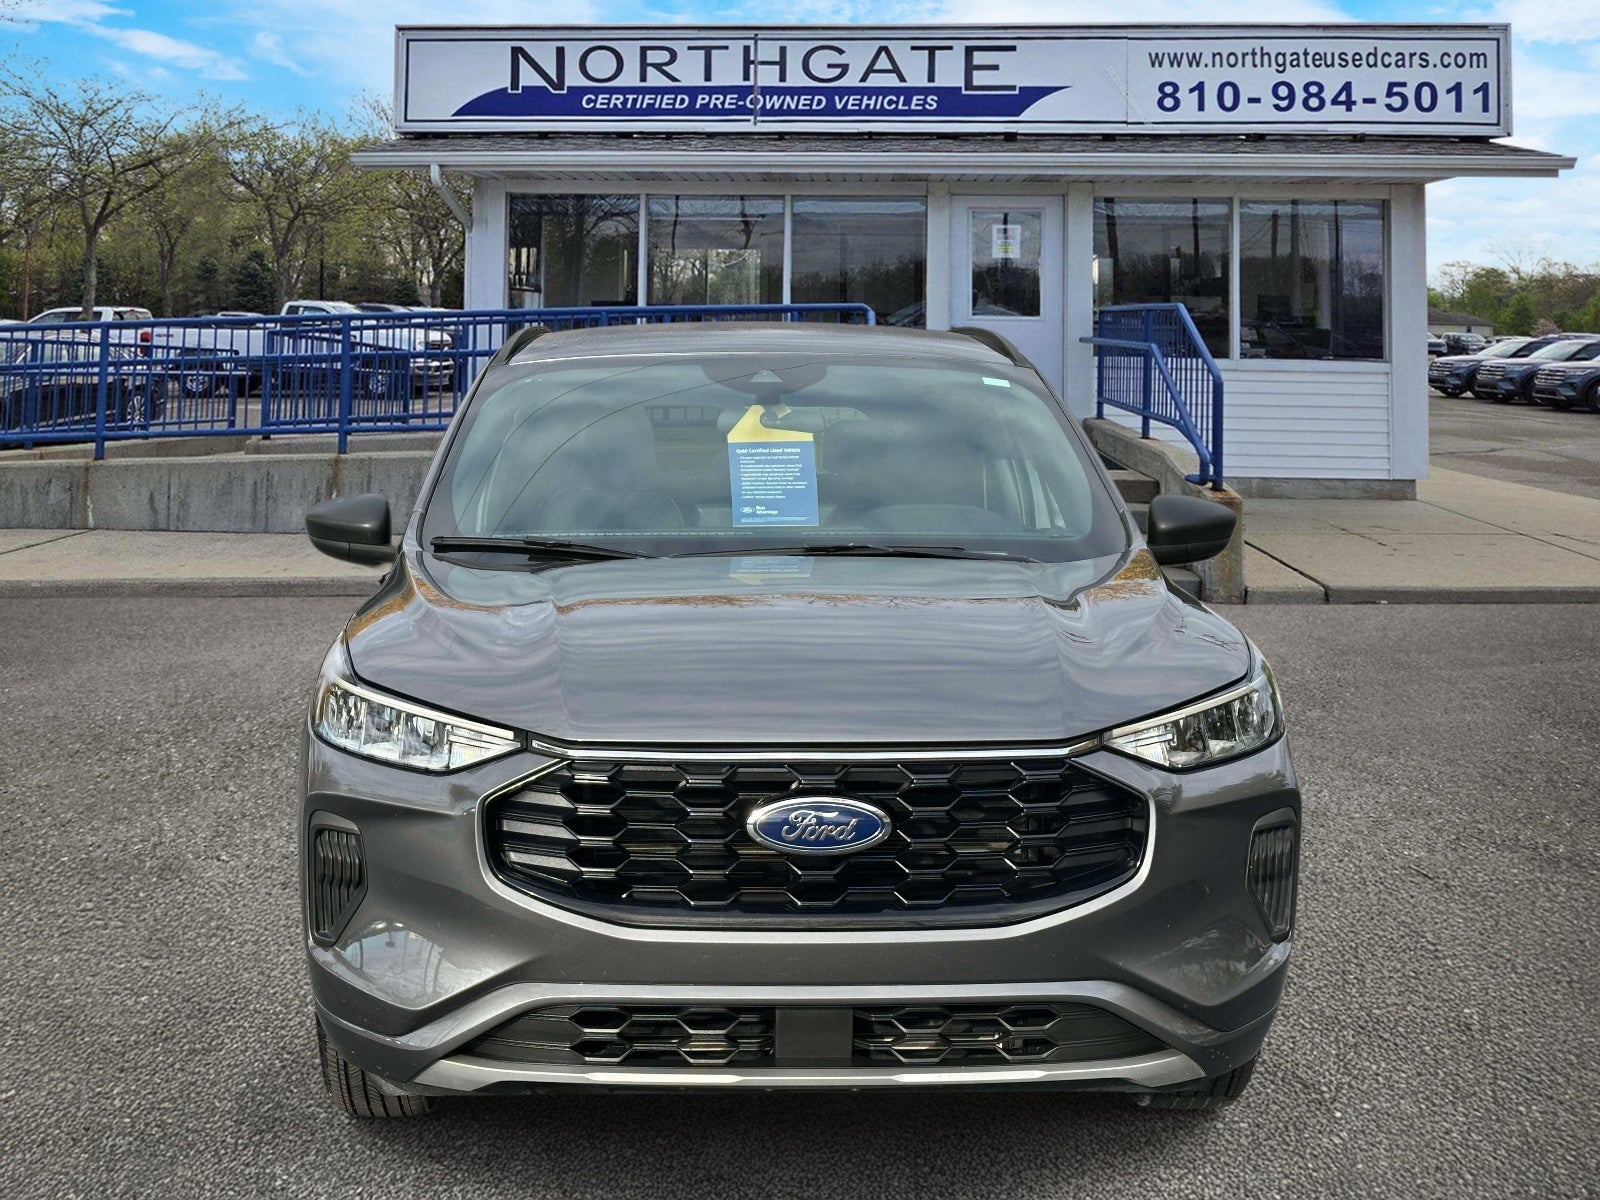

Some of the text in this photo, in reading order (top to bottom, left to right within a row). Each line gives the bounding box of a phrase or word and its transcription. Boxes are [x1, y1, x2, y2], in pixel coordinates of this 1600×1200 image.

[509, 44, 1018, 92] NORTHGATE
[1148, 46, 1489, 73] www.northgateusedcars.com
[581, 93, 940, 112] CERTIFIED PRE-OWNED VEHICLES
[1156, 80, 1491, 114] 810-984-5011
[781, 809, 859, 841] Ford
